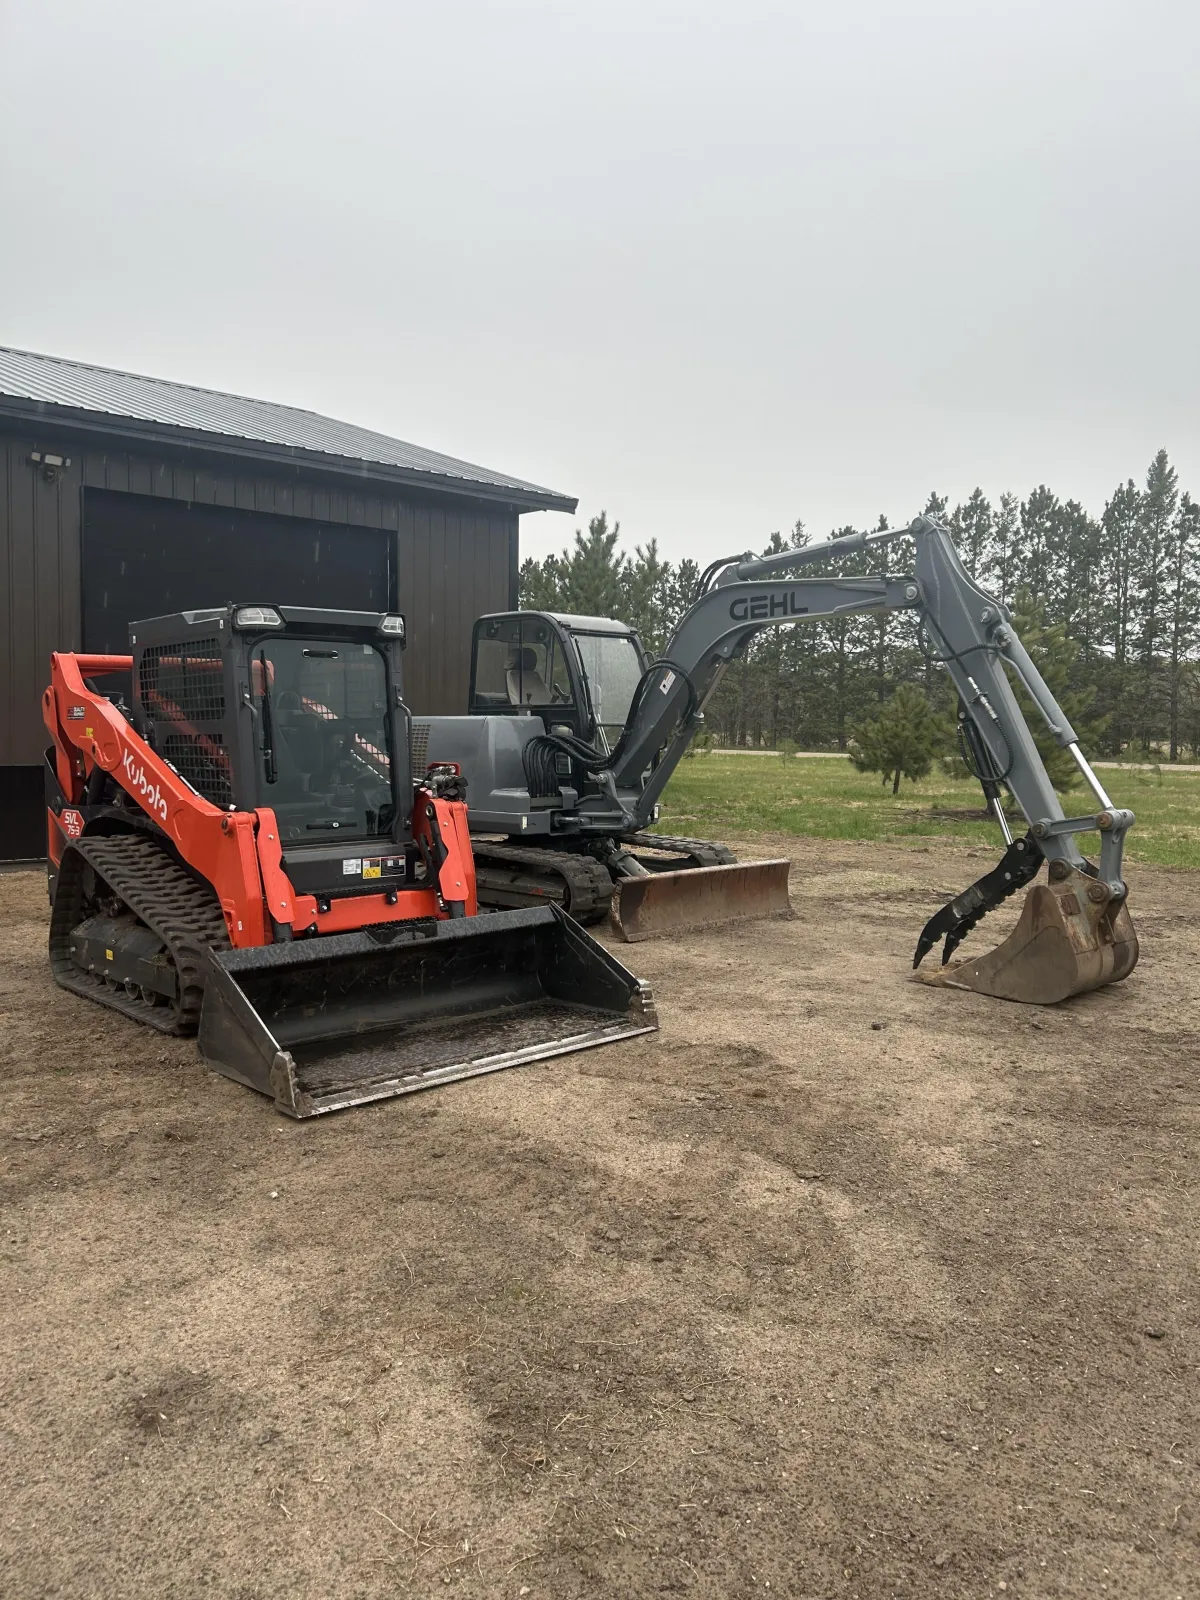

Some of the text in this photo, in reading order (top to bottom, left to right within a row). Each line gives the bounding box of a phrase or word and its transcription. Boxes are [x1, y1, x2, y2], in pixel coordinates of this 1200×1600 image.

[729, 591, 809, 621] GEHL
[123, 748, 168, 821] Kubota
[64, 812, 79, 825] SVL
[67, 825, 80, 835] 75-3
